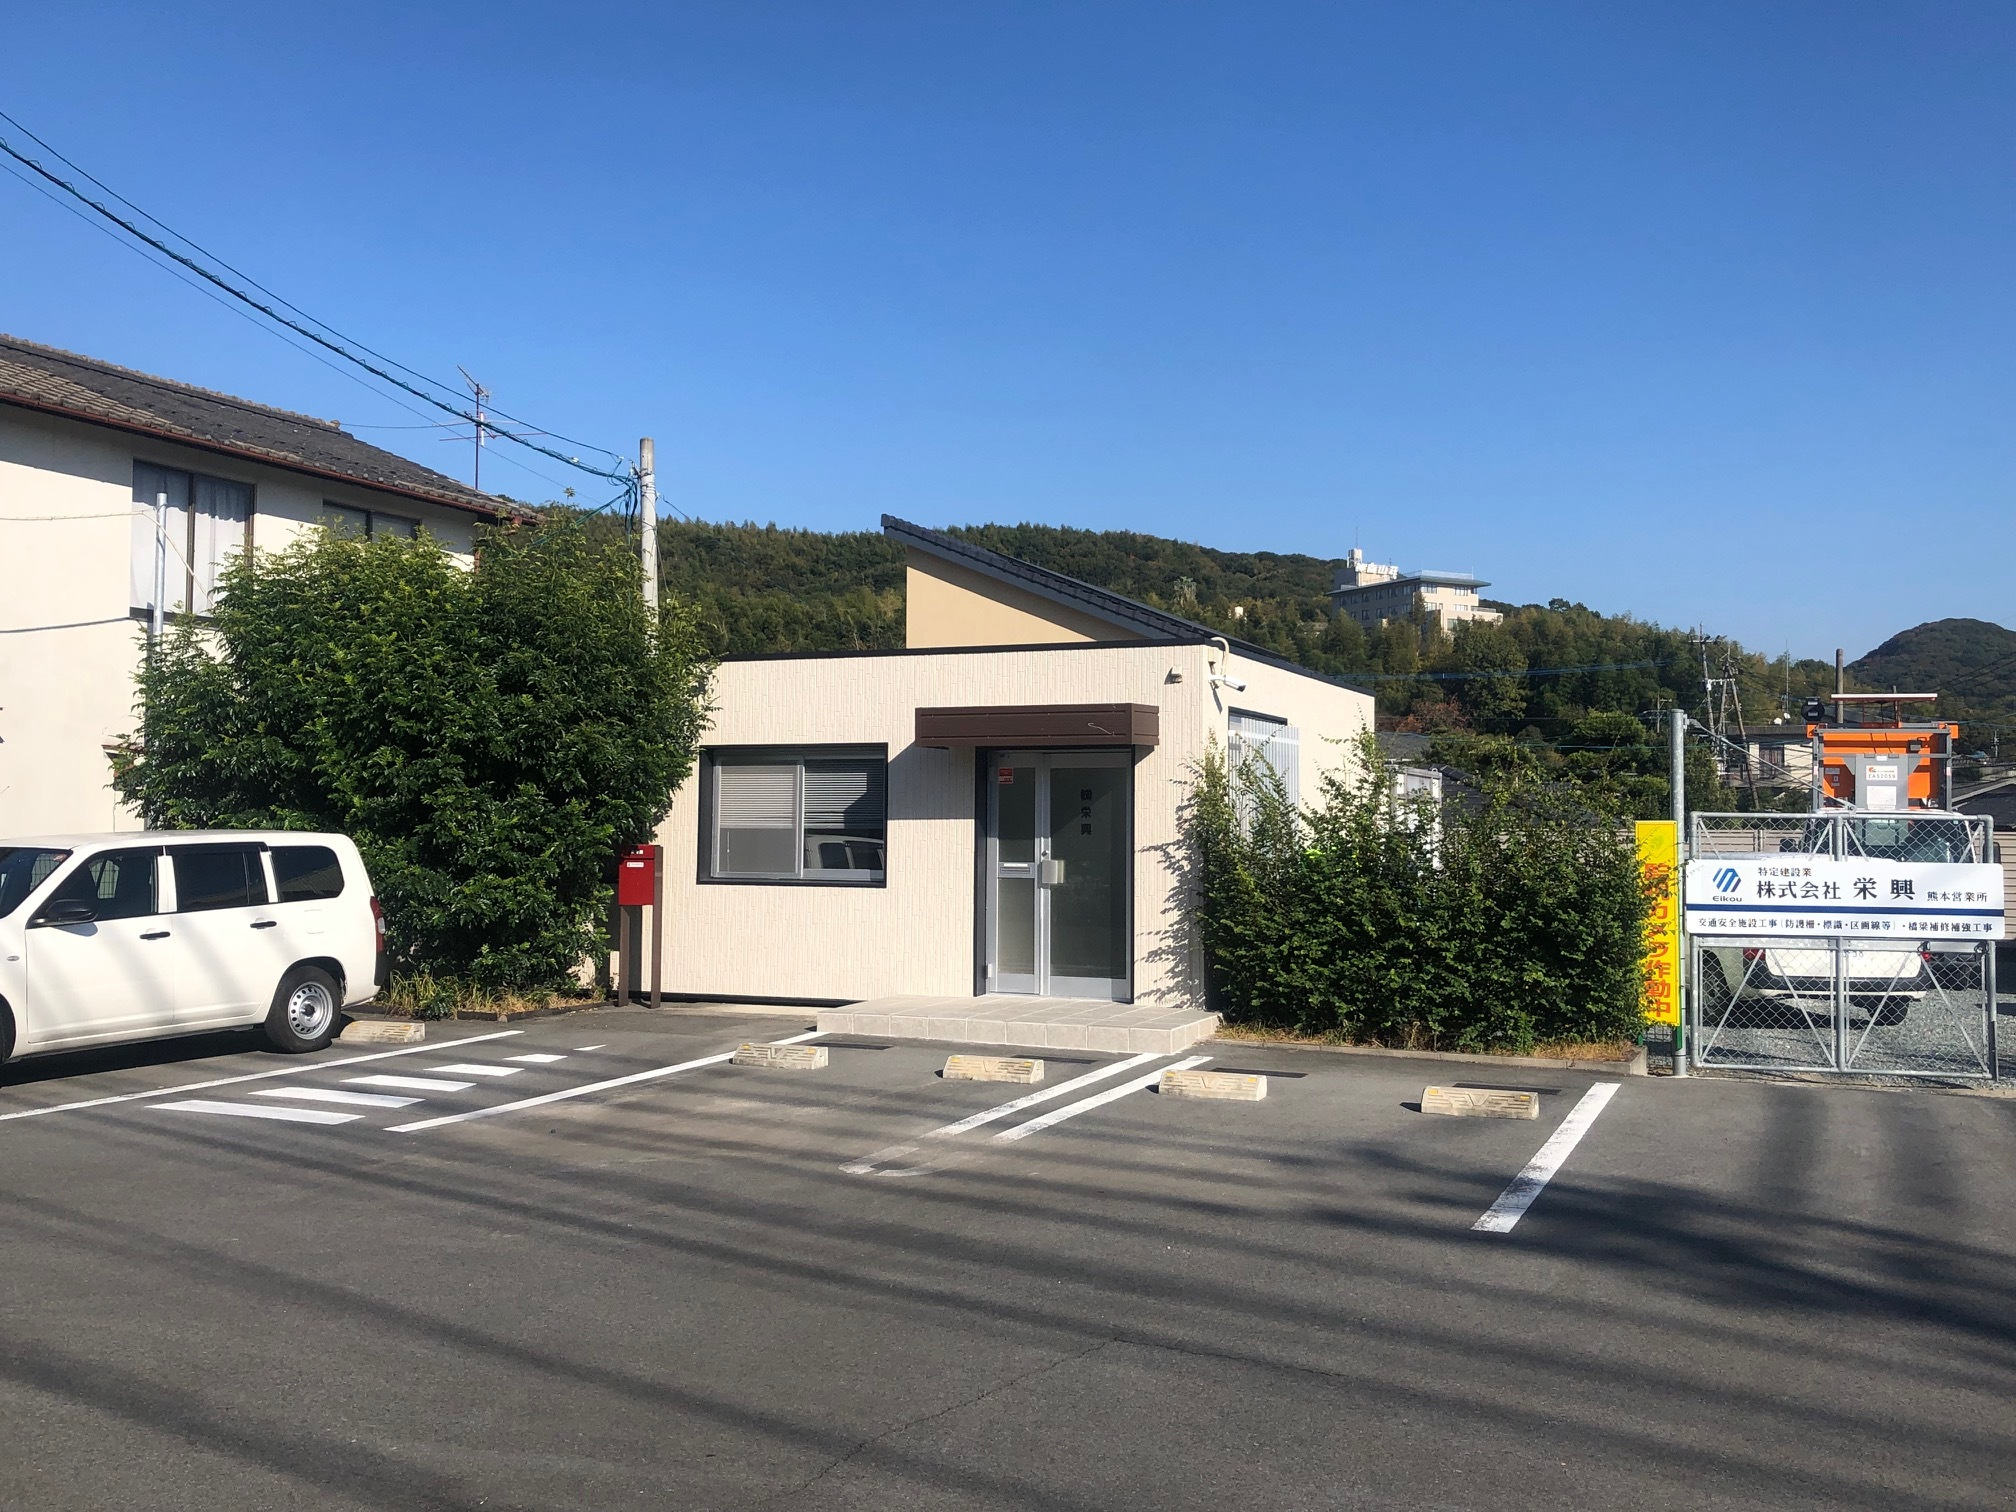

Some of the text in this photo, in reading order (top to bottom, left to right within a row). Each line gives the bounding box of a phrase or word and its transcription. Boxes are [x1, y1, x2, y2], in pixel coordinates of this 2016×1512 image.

[1758, 867, 1812, 877] 特定建設業
[1757, 880, 1841, 900] 株式会社
[1927, 890, 1988, 903] 熊本営業所
